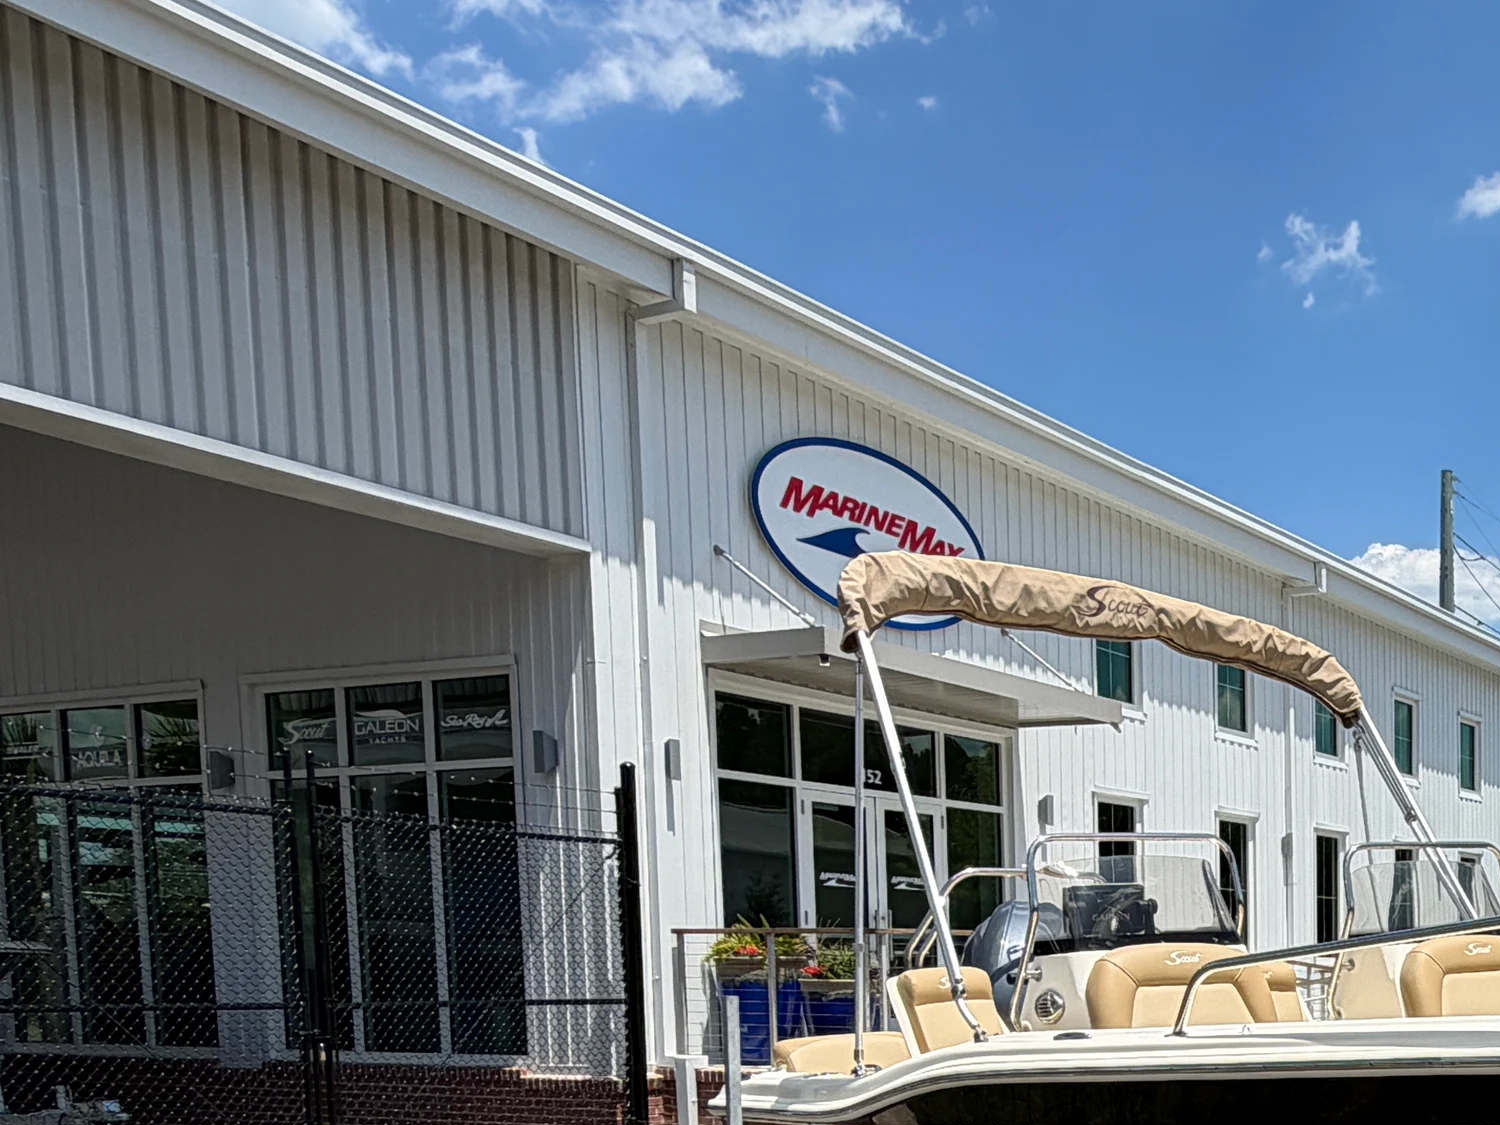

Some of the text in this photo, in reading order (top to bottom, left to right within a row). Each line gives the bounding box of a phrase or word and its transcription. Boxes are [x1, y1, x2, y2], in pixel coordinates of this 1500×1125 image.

[1070, 586, 1148, 617] Scout
[354, 718, 420, 736] GALEON
[369, 735, 407, 745] YACHTS
[863, 768, 882, 784] 52
[1164, 950, 1201, 966] Scout
